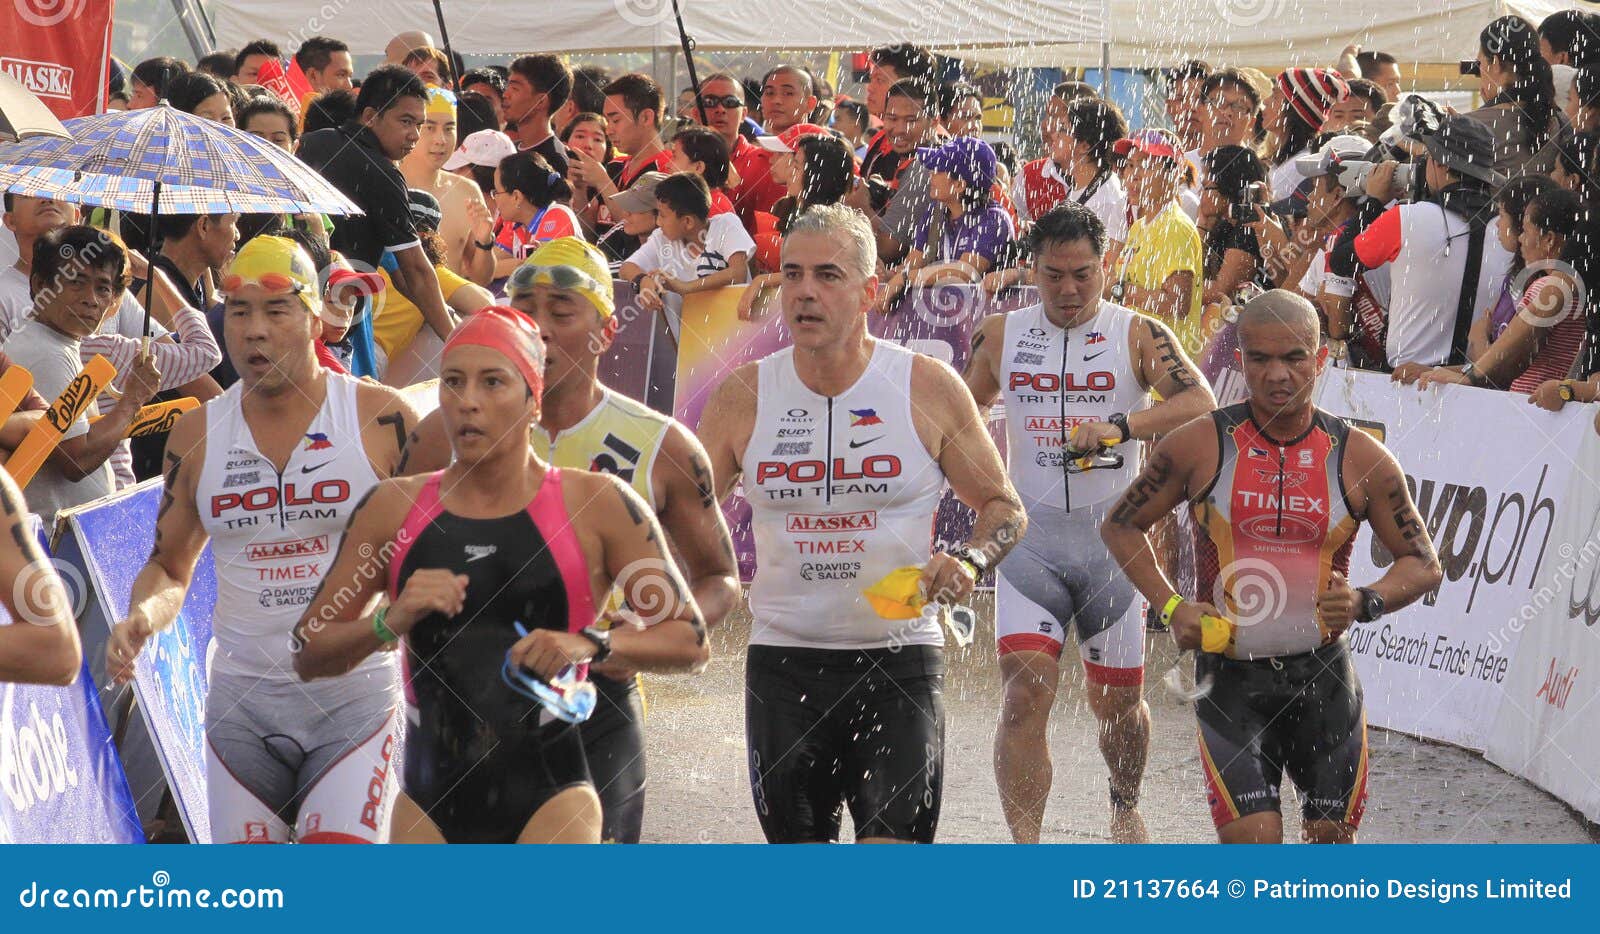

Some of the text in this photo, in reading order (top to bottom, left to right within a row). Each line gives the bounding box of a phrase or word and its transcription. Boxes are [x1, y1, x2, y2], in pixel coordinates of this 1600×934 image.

[1009, 371, 1116, 392] POLO
[1017, 395, 1106, 403] TRI TEAM
[777, 428, 815, 437] RUDY
[226, 459, 260, 470] RUDY
[757, 454, 902, 485] POLO
[211, 479, 350, 518] POLO
[765, 483, 888, 500] TRI TEAM
[1237, 490, 1323, 514] TIMEX
[224, 508, 337, 530] TRI TEAM
[789, 514, 873, 530] ALASKA
[251, 538, 324, 559] ALASKA
[794, 540, 865, 554] TIMEX
[256, 563, 320, 581] TIMEX
[815, 561, 861, 572] DAVID'S
[818, 571, 857, 580] SALON
[274, 586, 317, 597] DAVID'S
[1348, 624, 1508, 684] our Search Ends Here
[1536, 657, 1578, 710] Audi
[360, 734, 392, 831] POLO
